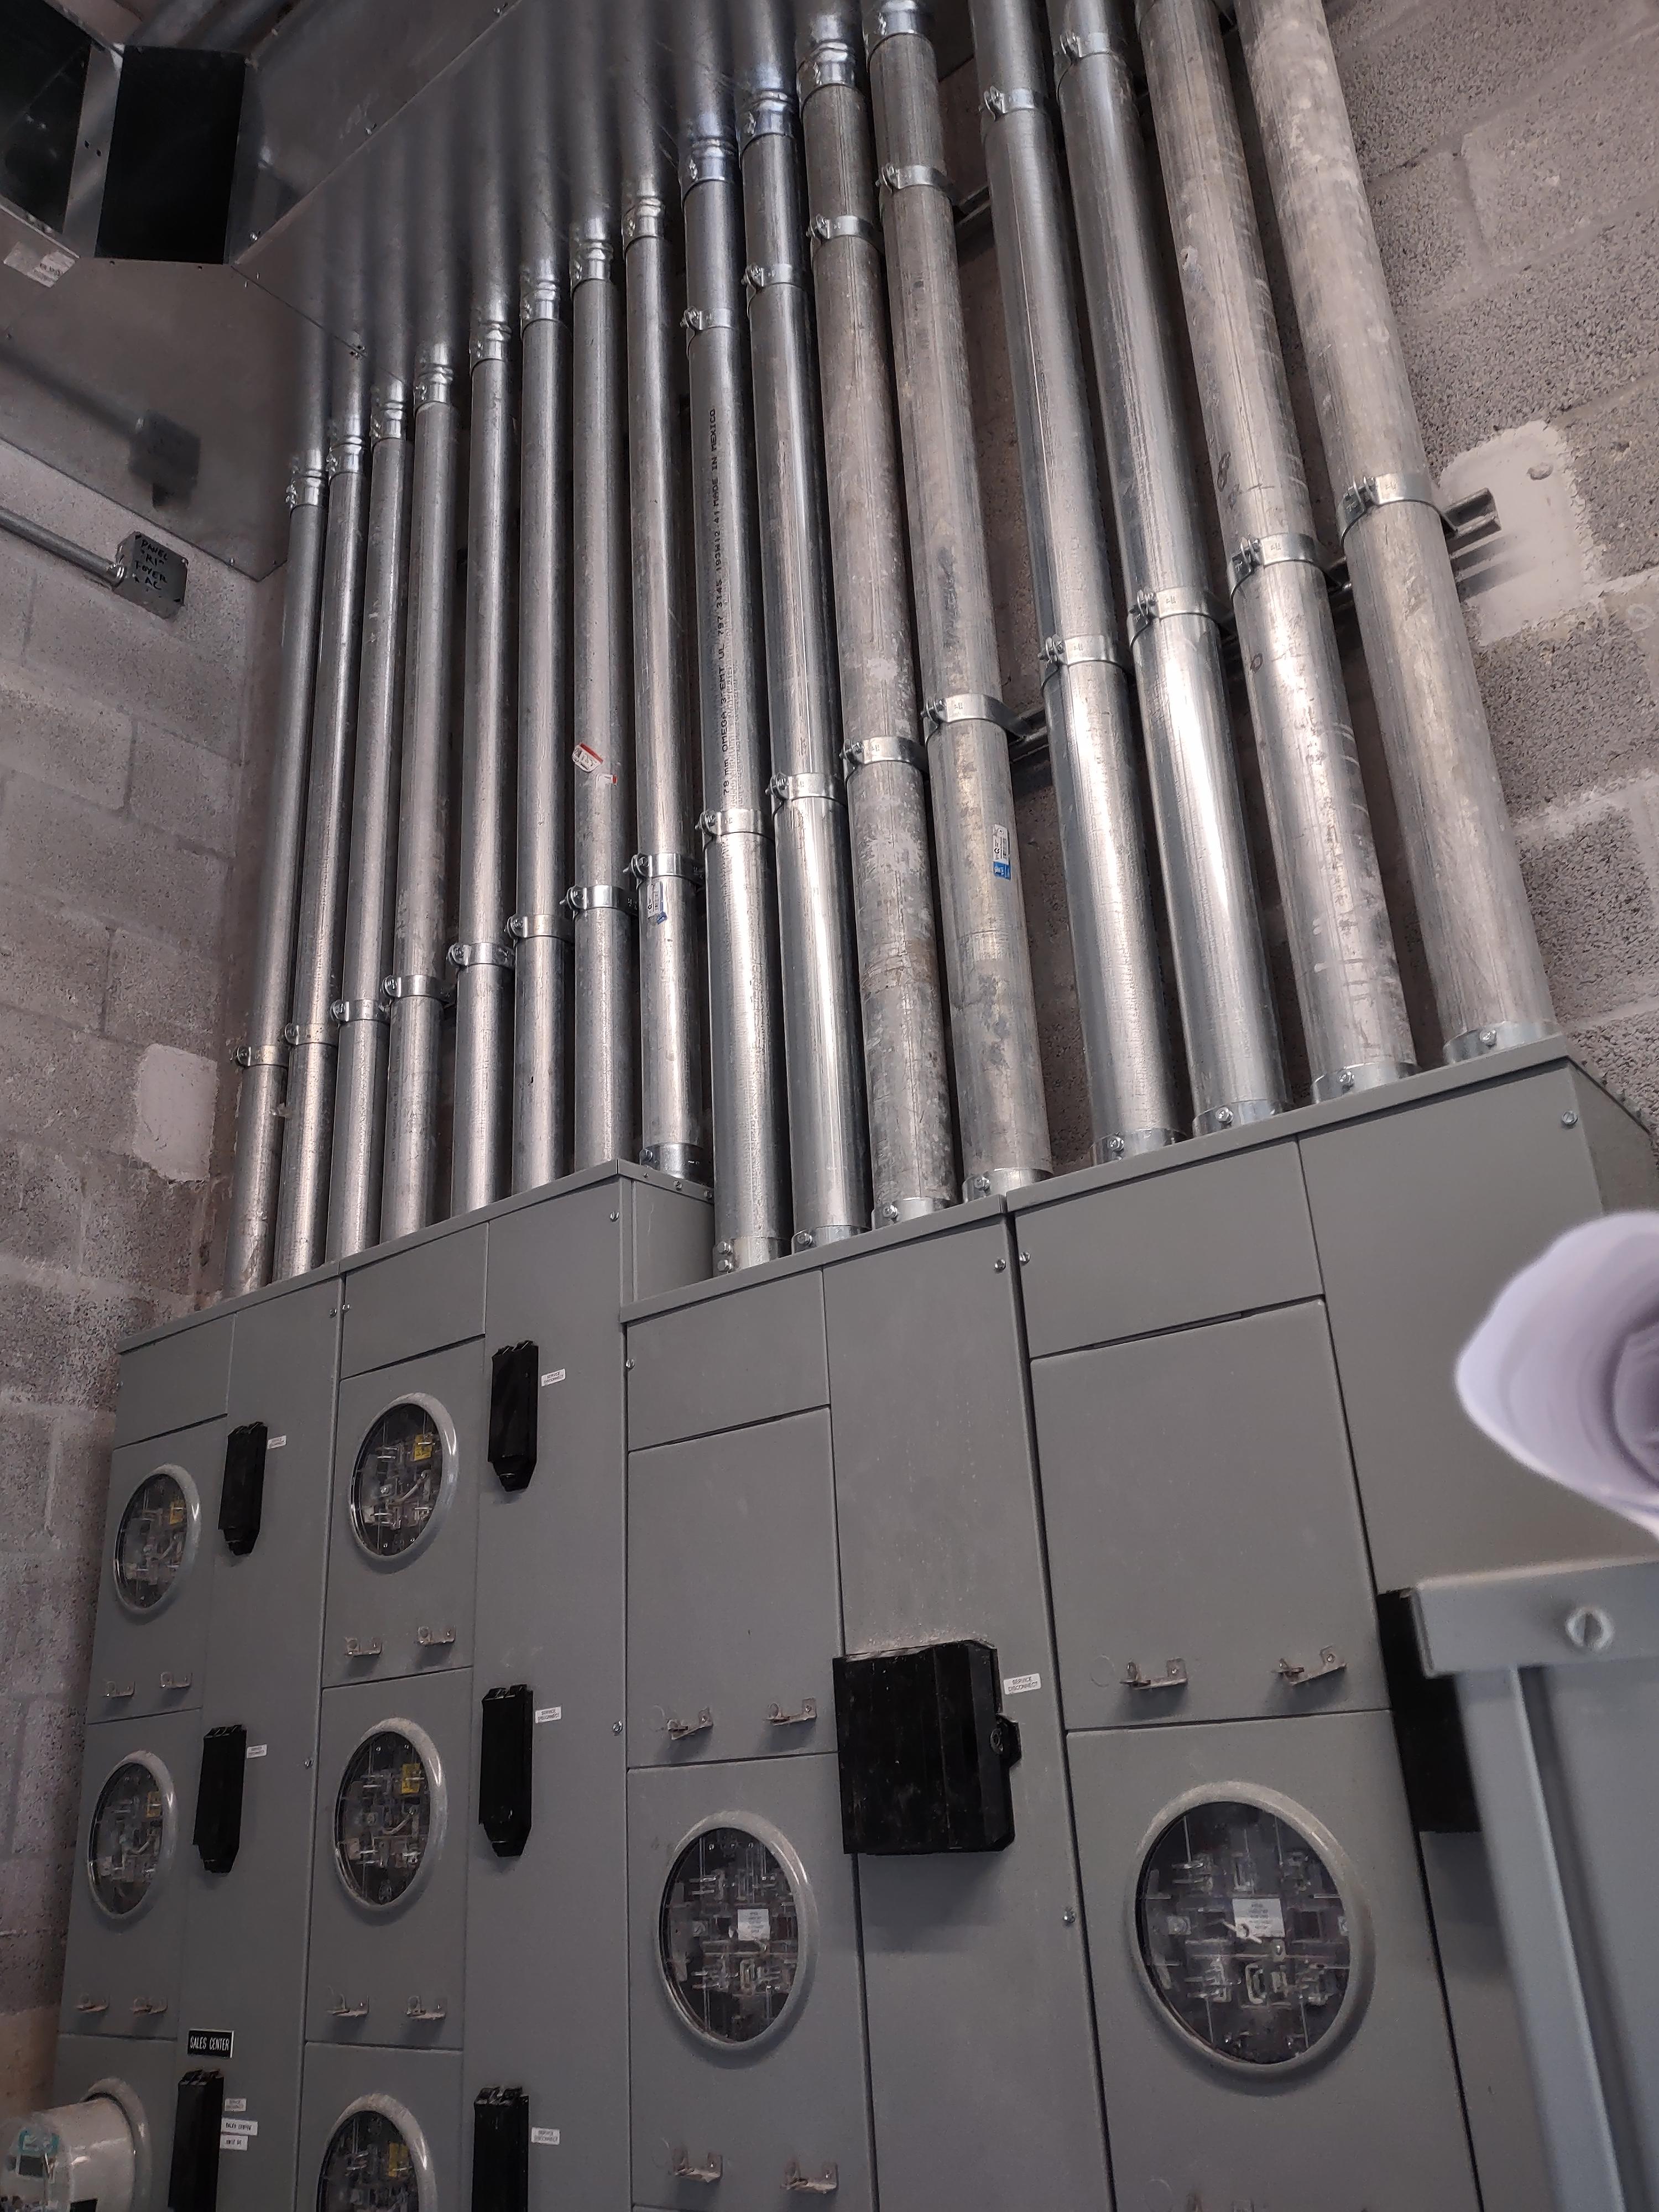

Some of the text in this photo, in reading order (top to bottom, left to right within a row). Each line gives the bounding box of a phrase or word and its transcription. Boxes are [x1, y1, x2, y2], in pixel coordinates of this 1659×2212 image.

[709, 408, 717, 452] MEXICO
[711, 456, 718, 471] IN
[718, 644, 725, 660] UL
[190, 2035, 229, 2051] SALES CENTER
